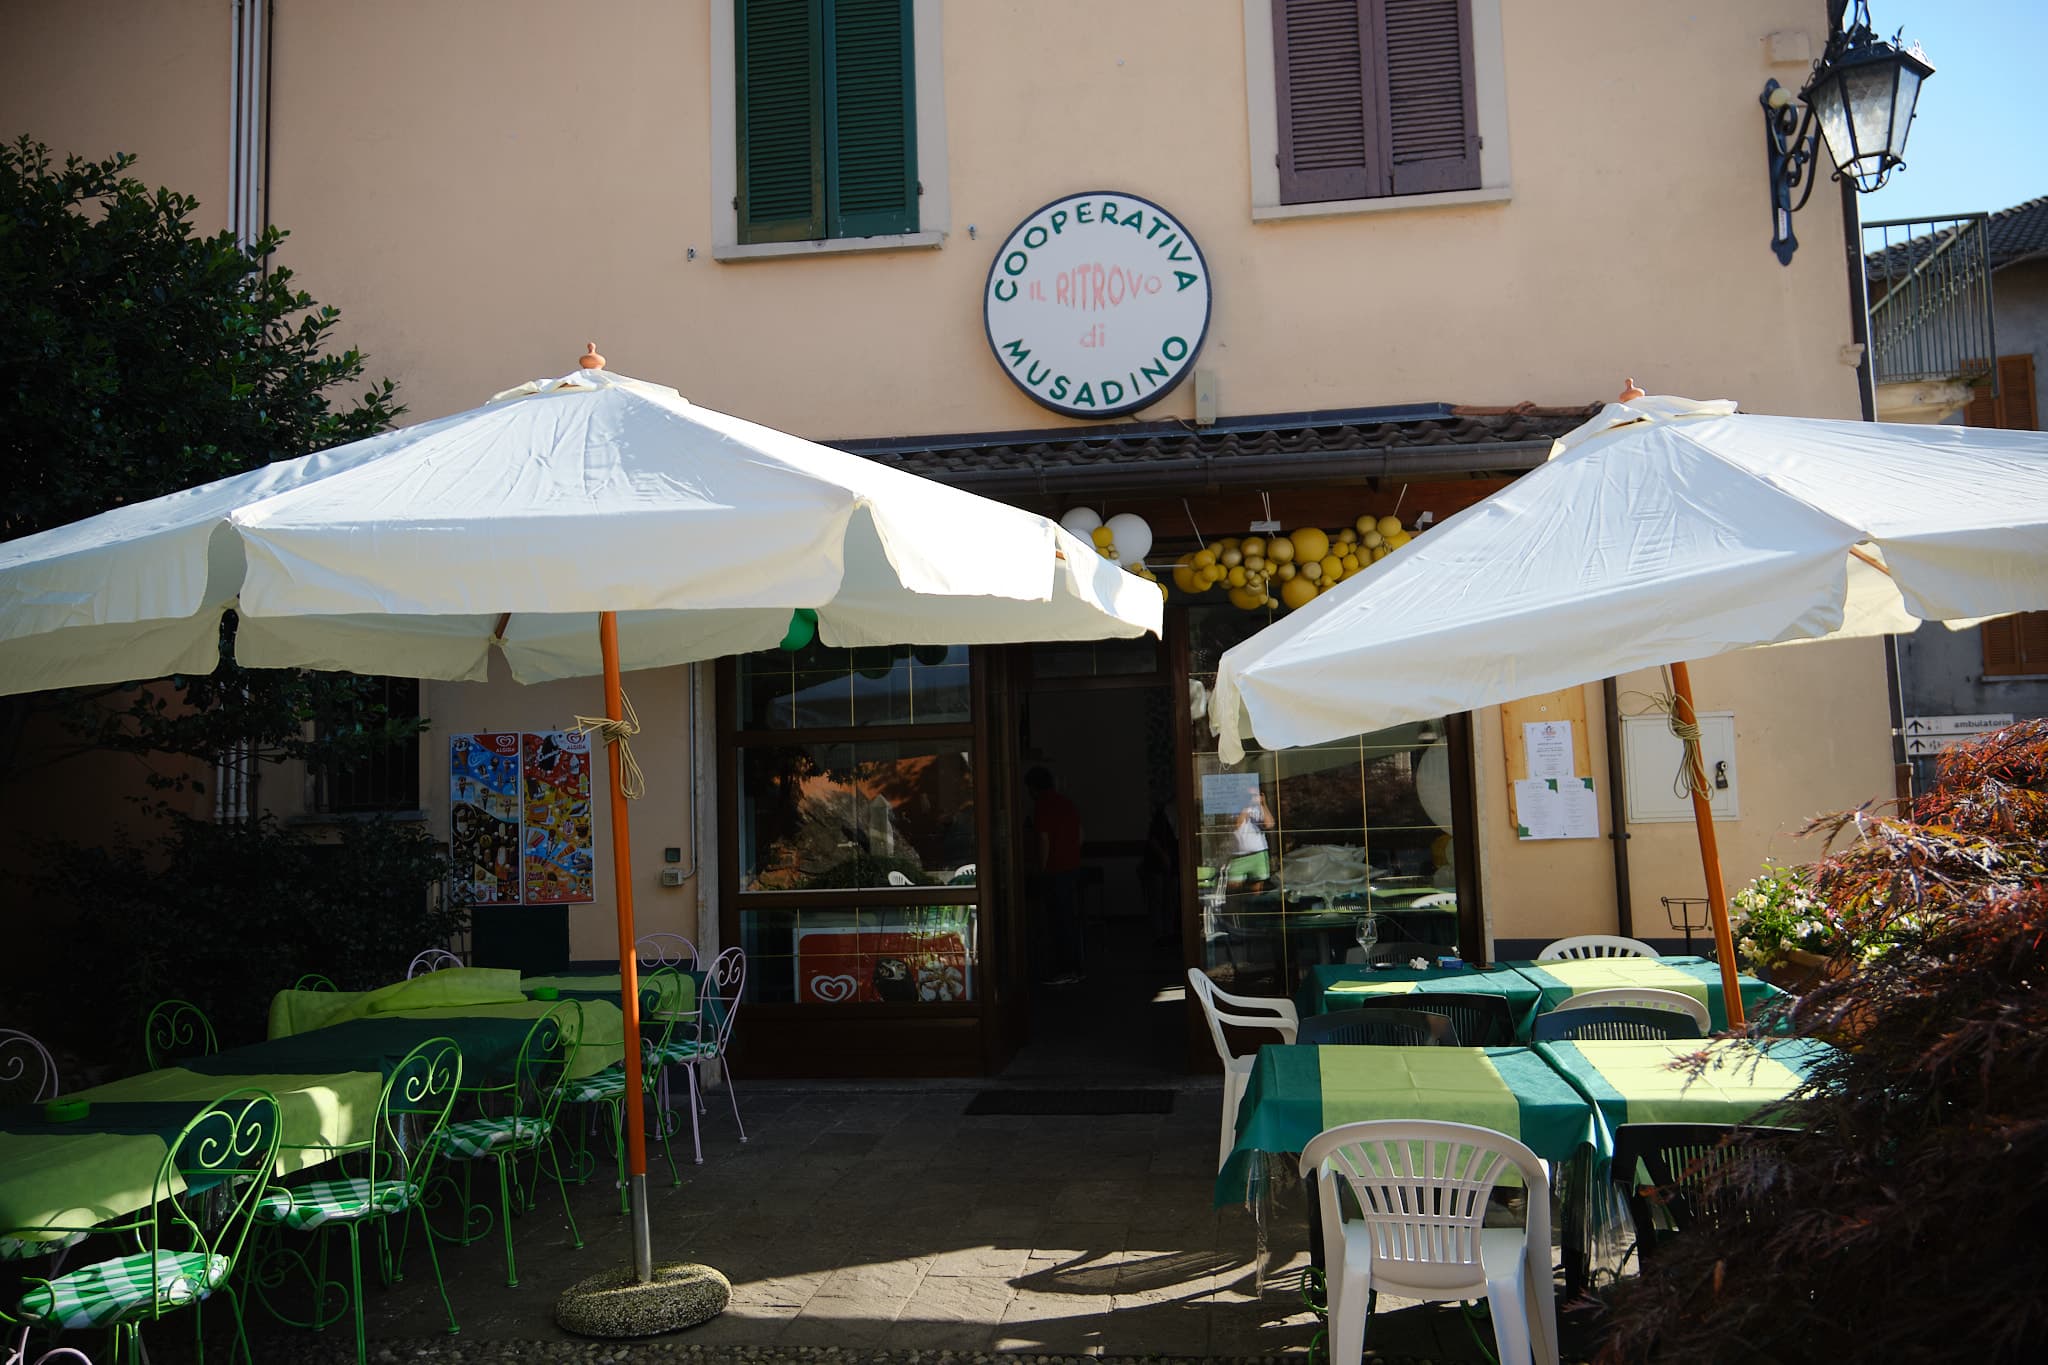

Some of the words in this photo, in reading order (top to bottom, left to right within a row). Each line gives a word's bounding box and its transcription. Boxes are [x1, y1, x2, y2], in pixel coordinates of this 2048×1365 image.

[995, 202, 1198, 302] COOPERATIVA
[1029, 280, 1046, 302] IL
[1056, 263, 1162, 312] RITROVO
[1080, 323, 1105, 348] di
[1001, 336, 1188, 408] MUSADINO
[1954, 719, 2011, 728] ambulatorio
